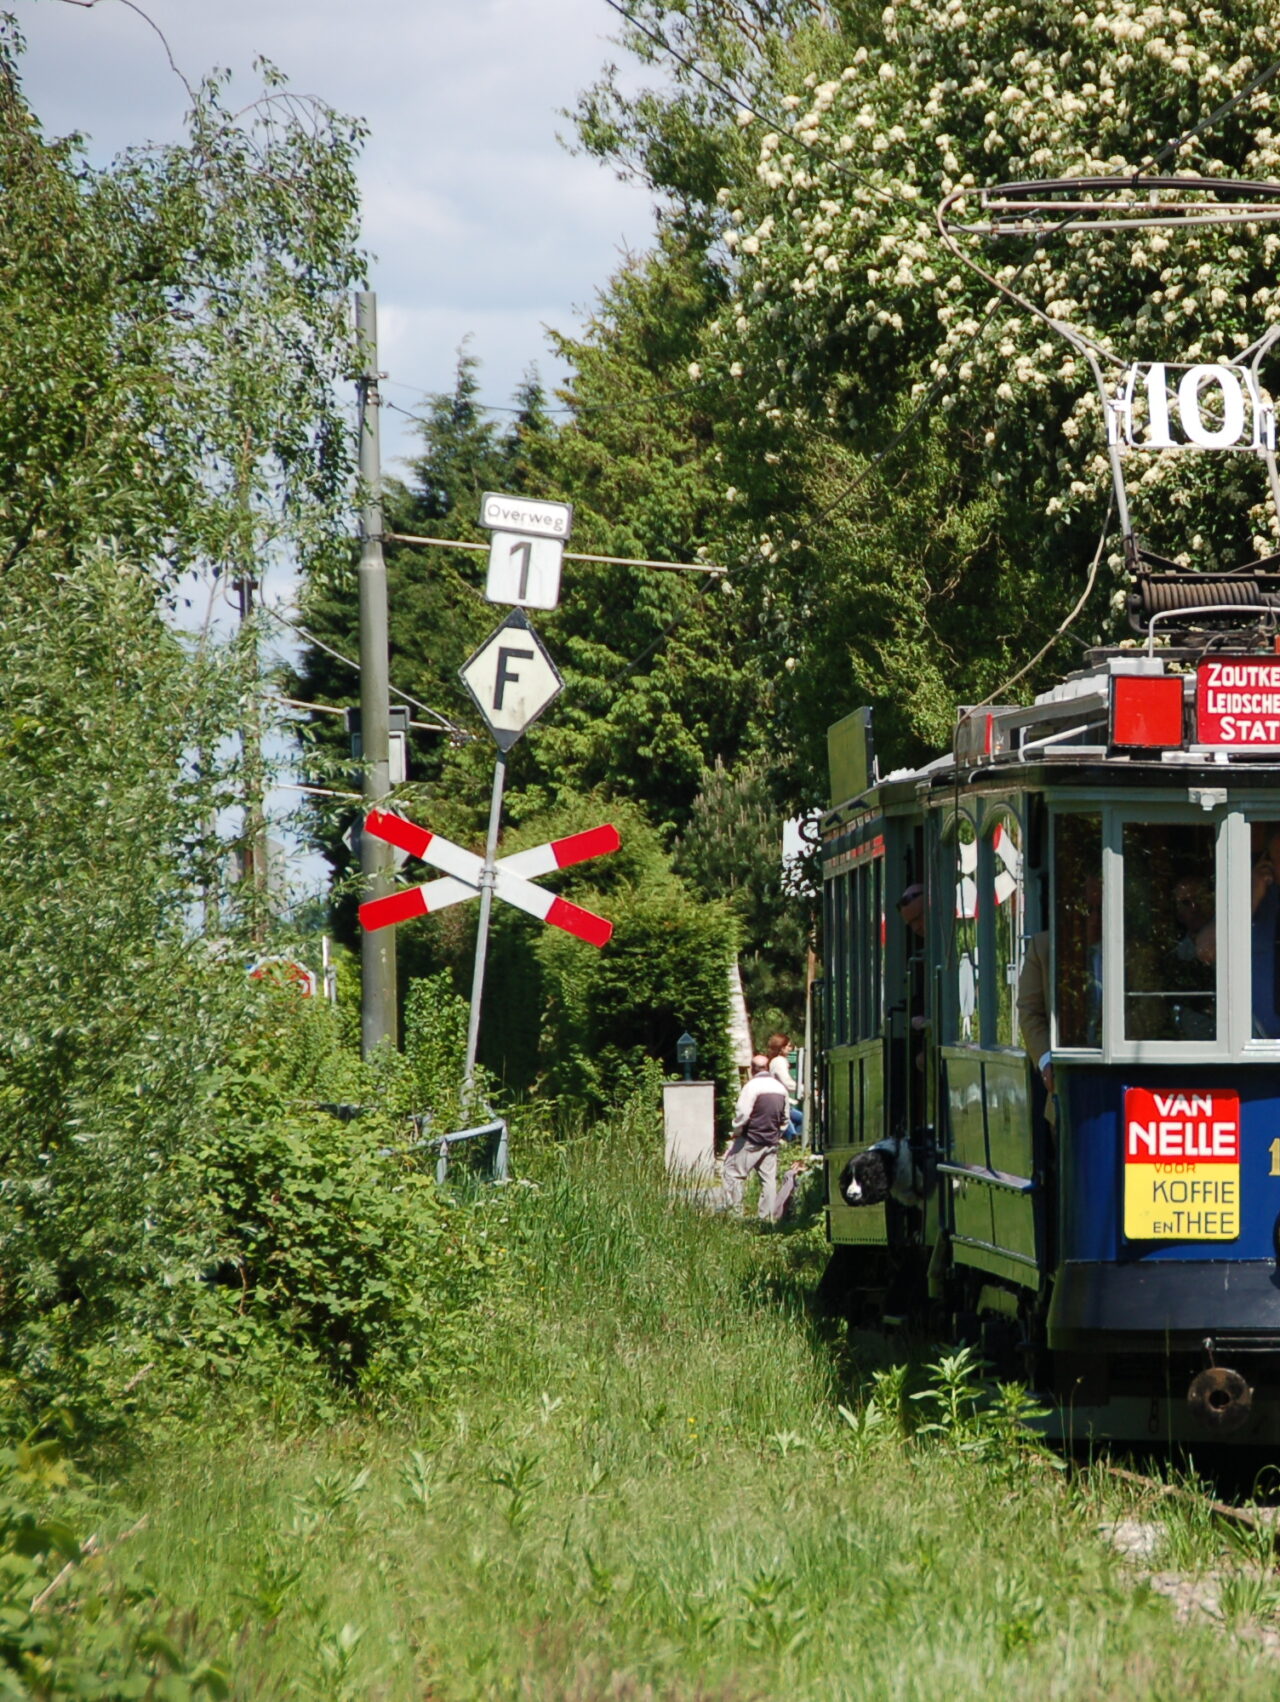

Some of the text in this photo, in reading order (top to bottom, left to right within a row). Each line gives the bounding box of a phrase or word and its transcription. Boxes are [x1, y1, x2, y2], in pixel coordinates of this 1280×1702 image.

[1142, 362, 1245, 448] 10
[487, 504, 564, 532] Overweg
[509, 541, 532, 600] 1
[492, 646, 534, 710] F
[1153, 1094, 1212, 1117] VAN
[1128, 1121, 1236, 1156] NELLE
[1154, 1163, 1196, 1174] VOOR
[1153, 1180, 1234, 1204] KOFFIE
[1153, 1211, 1234, 1234] EN THEE
